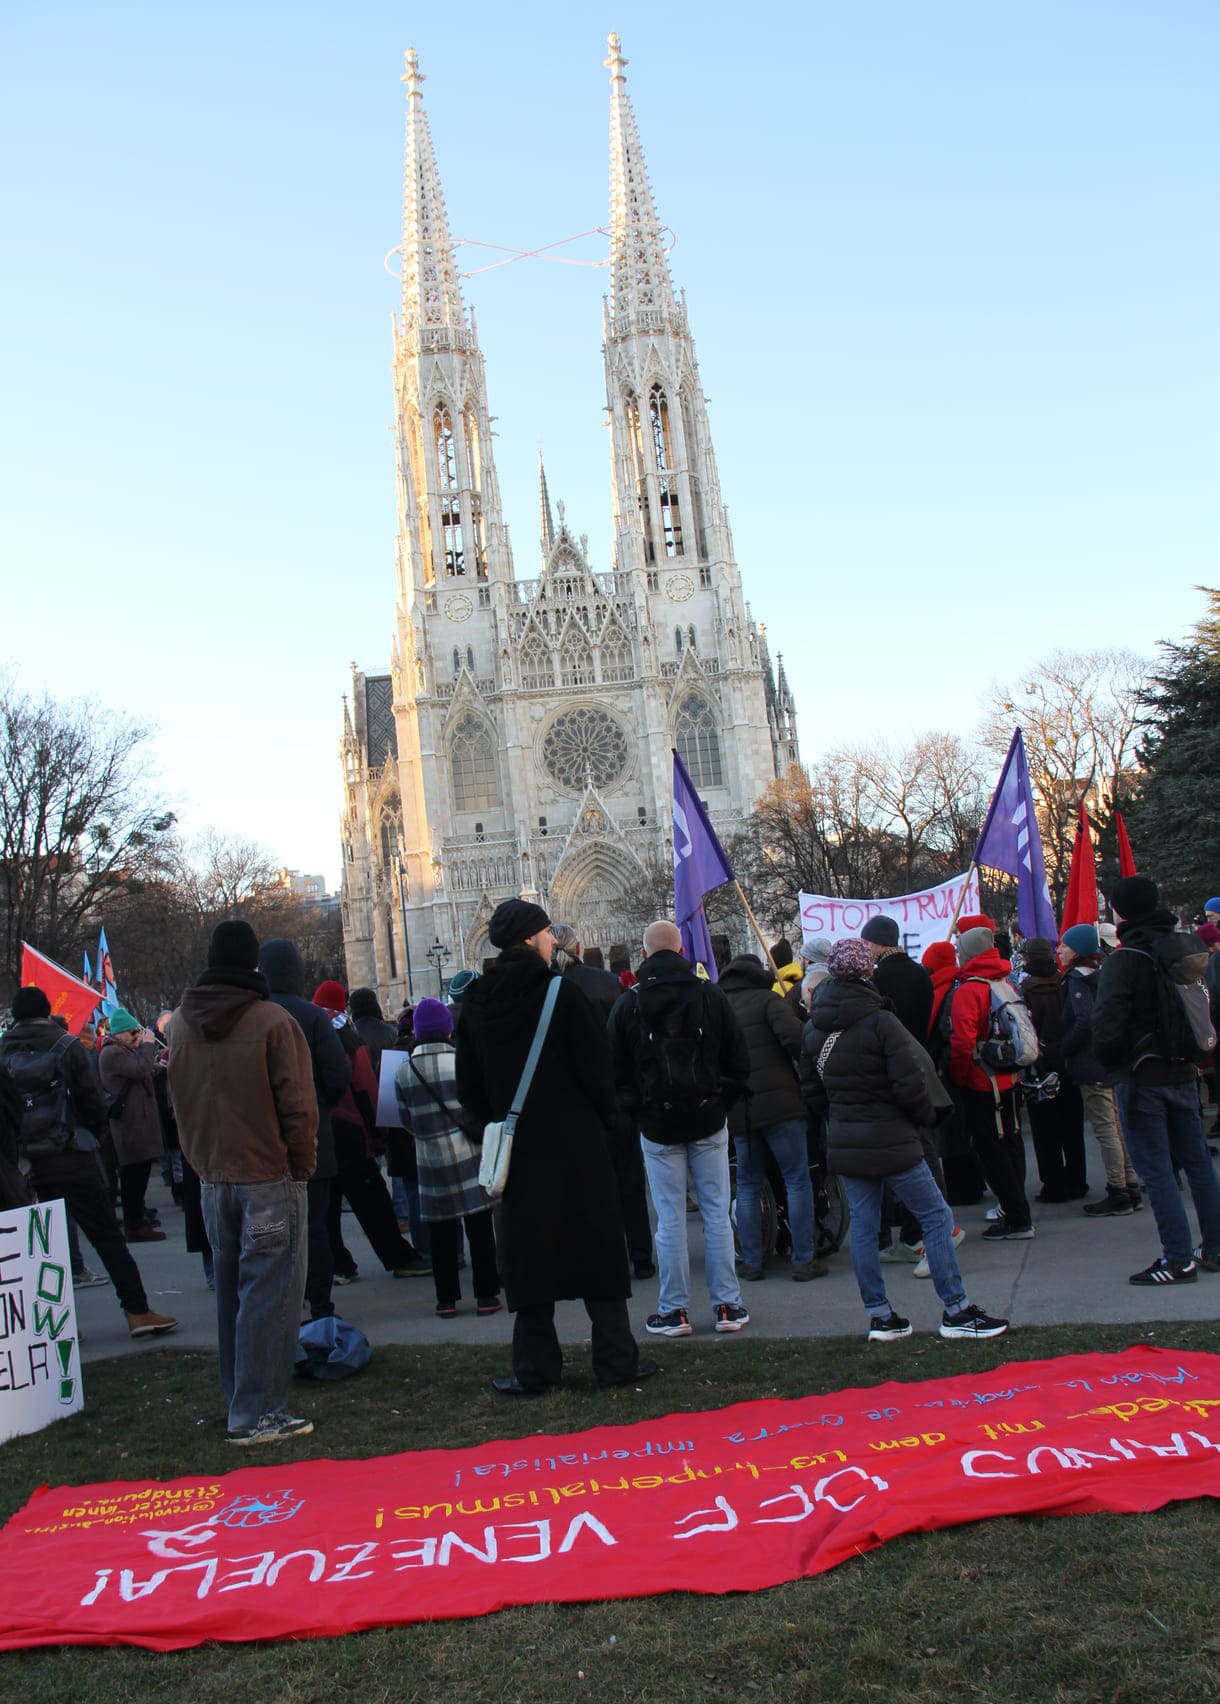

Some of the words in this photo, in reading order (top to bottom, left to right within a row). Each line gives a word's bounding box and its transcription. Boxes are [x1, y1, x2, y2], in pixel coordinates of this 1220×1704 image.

[803, 902, 883, 932] STOP
[28, 1207, 76, 1405] NOW!
[869, 1431, 947, 1451] dem
[977, 1419, 1046, 1440] mit
[672, 1466, 890, 1540] OFF
[80, 1510, 619, 1606] VENEZUELA!
